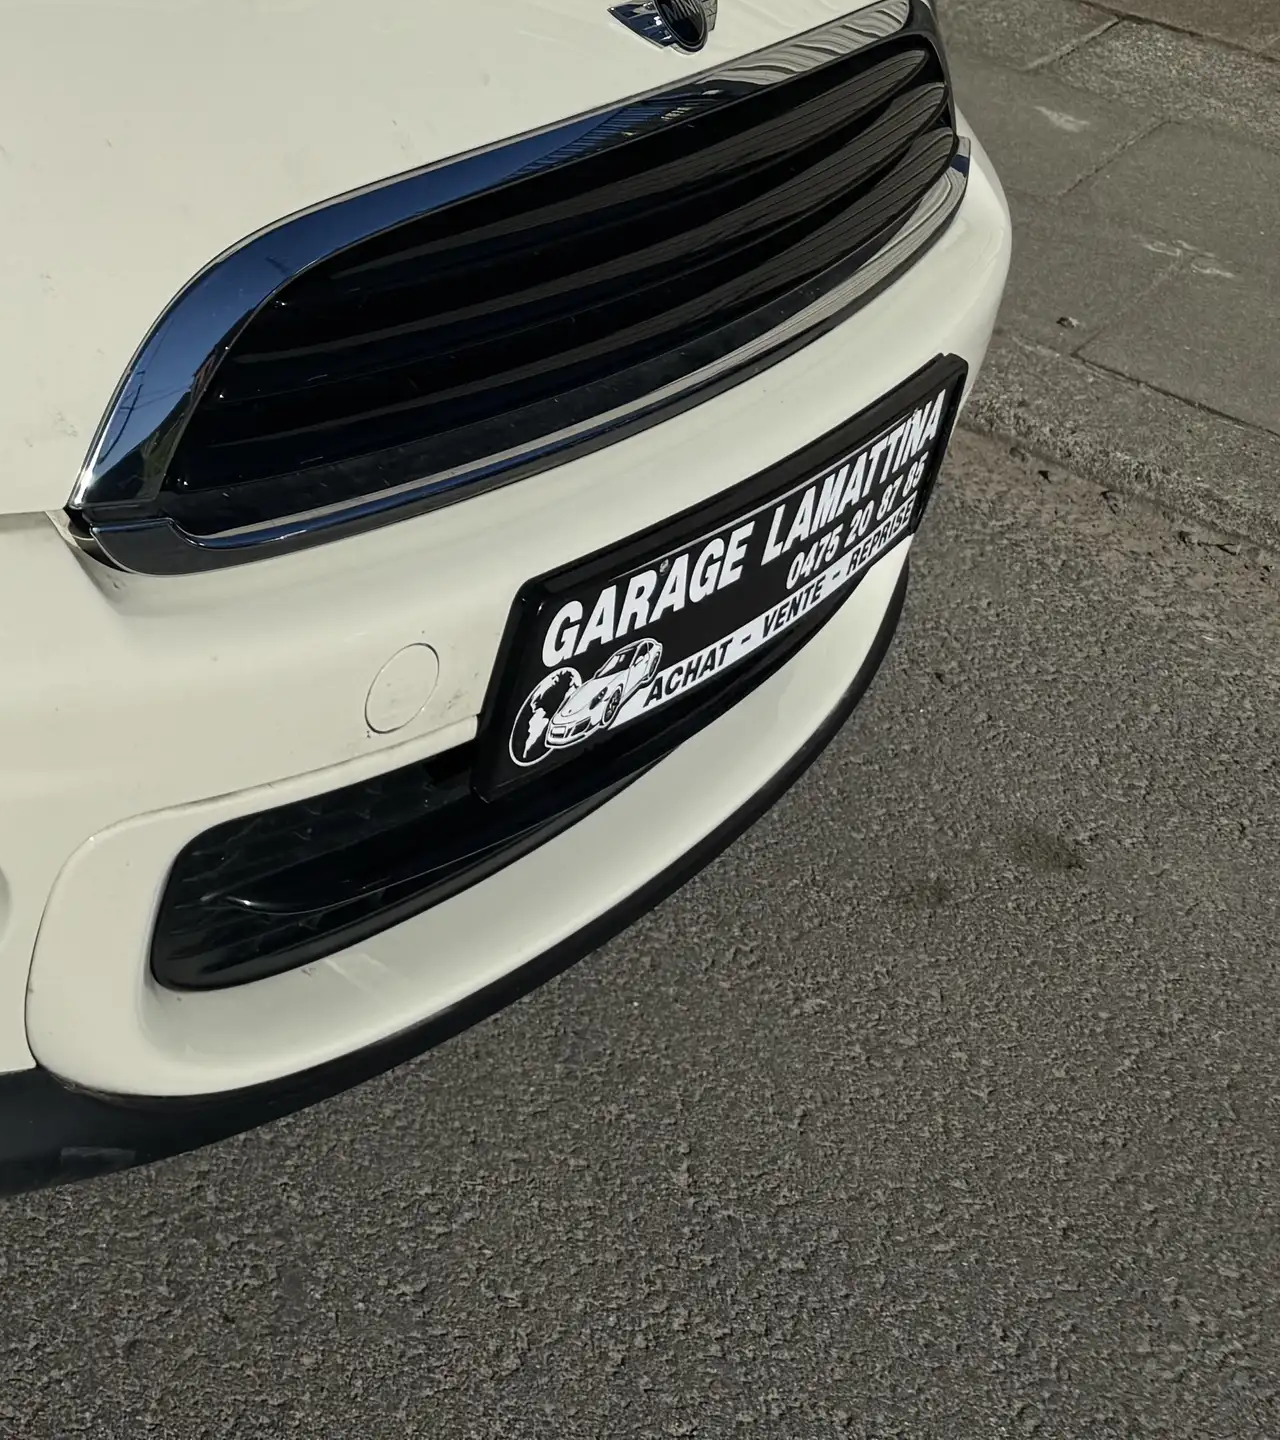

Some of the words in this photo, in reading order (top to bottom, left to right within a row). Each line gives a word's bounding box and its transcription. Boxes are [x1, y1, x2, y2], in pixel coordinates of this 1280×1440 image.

[542, 521, 755, 667] GARAGE
[761, 389, 946, 565] LAMATTINA
[644, 640, 732, 708] ACHAT
[762, 575, 826, 639] VENTE
[847, 496, 916, 576] REPRISE
[786, 523, 844, 590] 0475
[844, 500, 875, 548] 20
[876, 475, 904, 521] 87
[902, 451, 928, 497] 85
